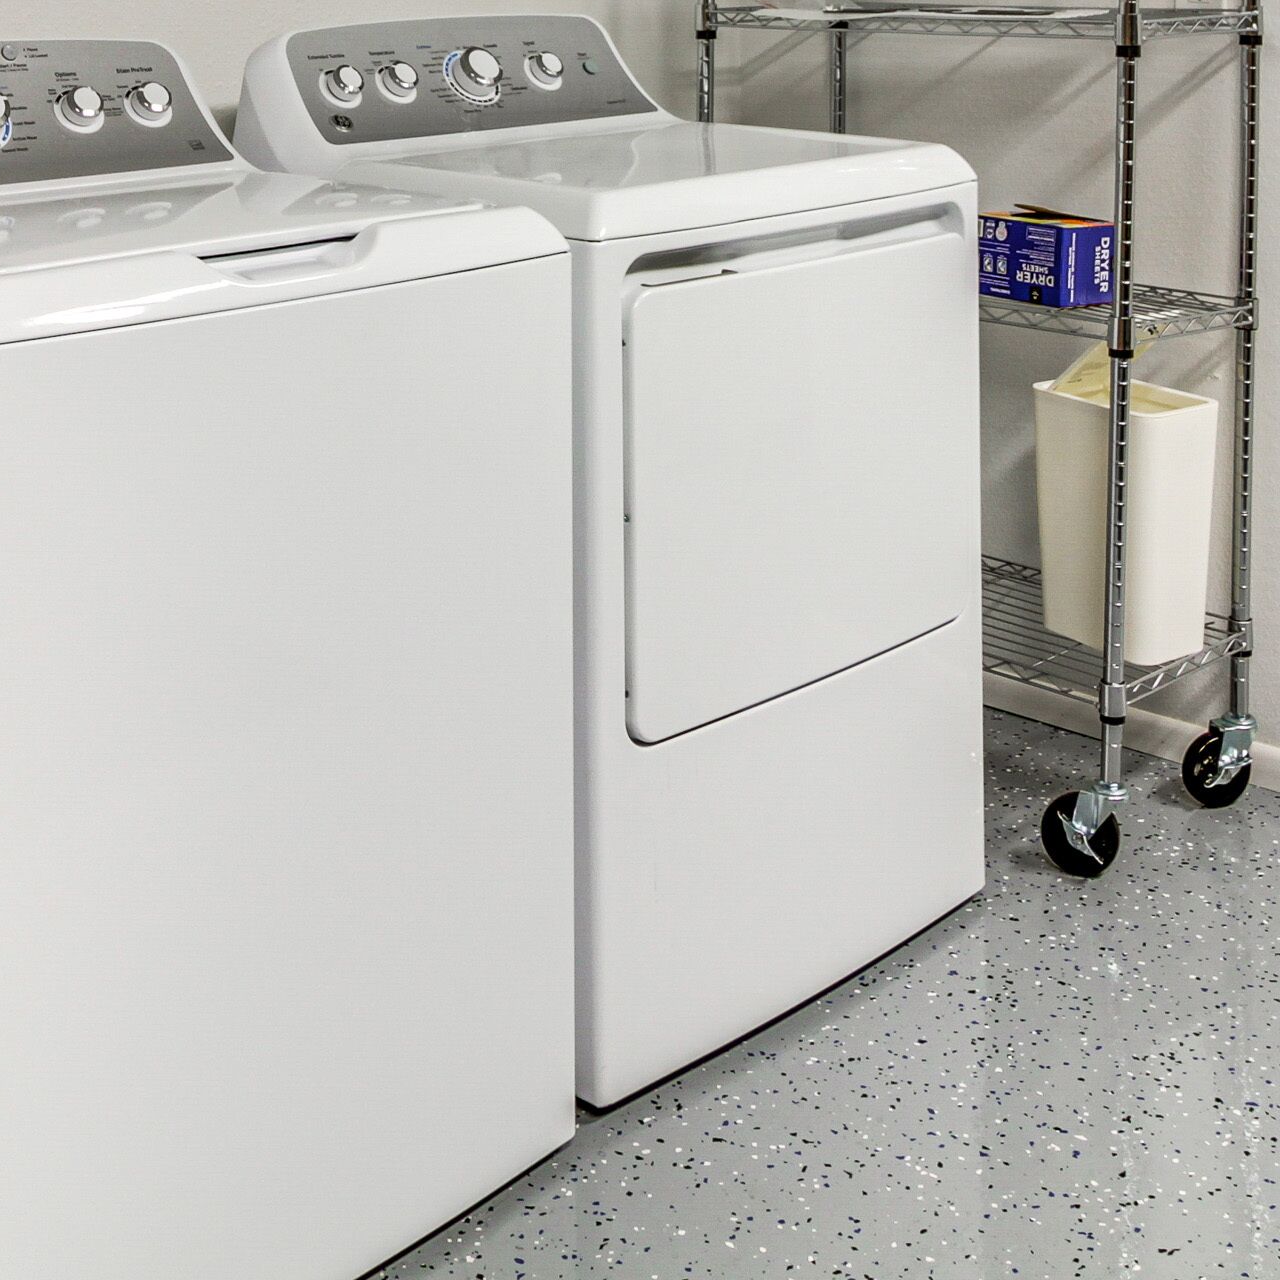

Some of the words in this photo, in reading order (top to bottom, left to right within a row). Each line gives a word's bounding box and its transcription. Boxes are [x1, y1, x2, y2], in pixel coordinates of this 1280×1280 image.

[1022, 263, 1049, 274] SHEETS
[1099, 236, 1110, 293] DRYER
[1015, 270, 1054, 287] DRYER
